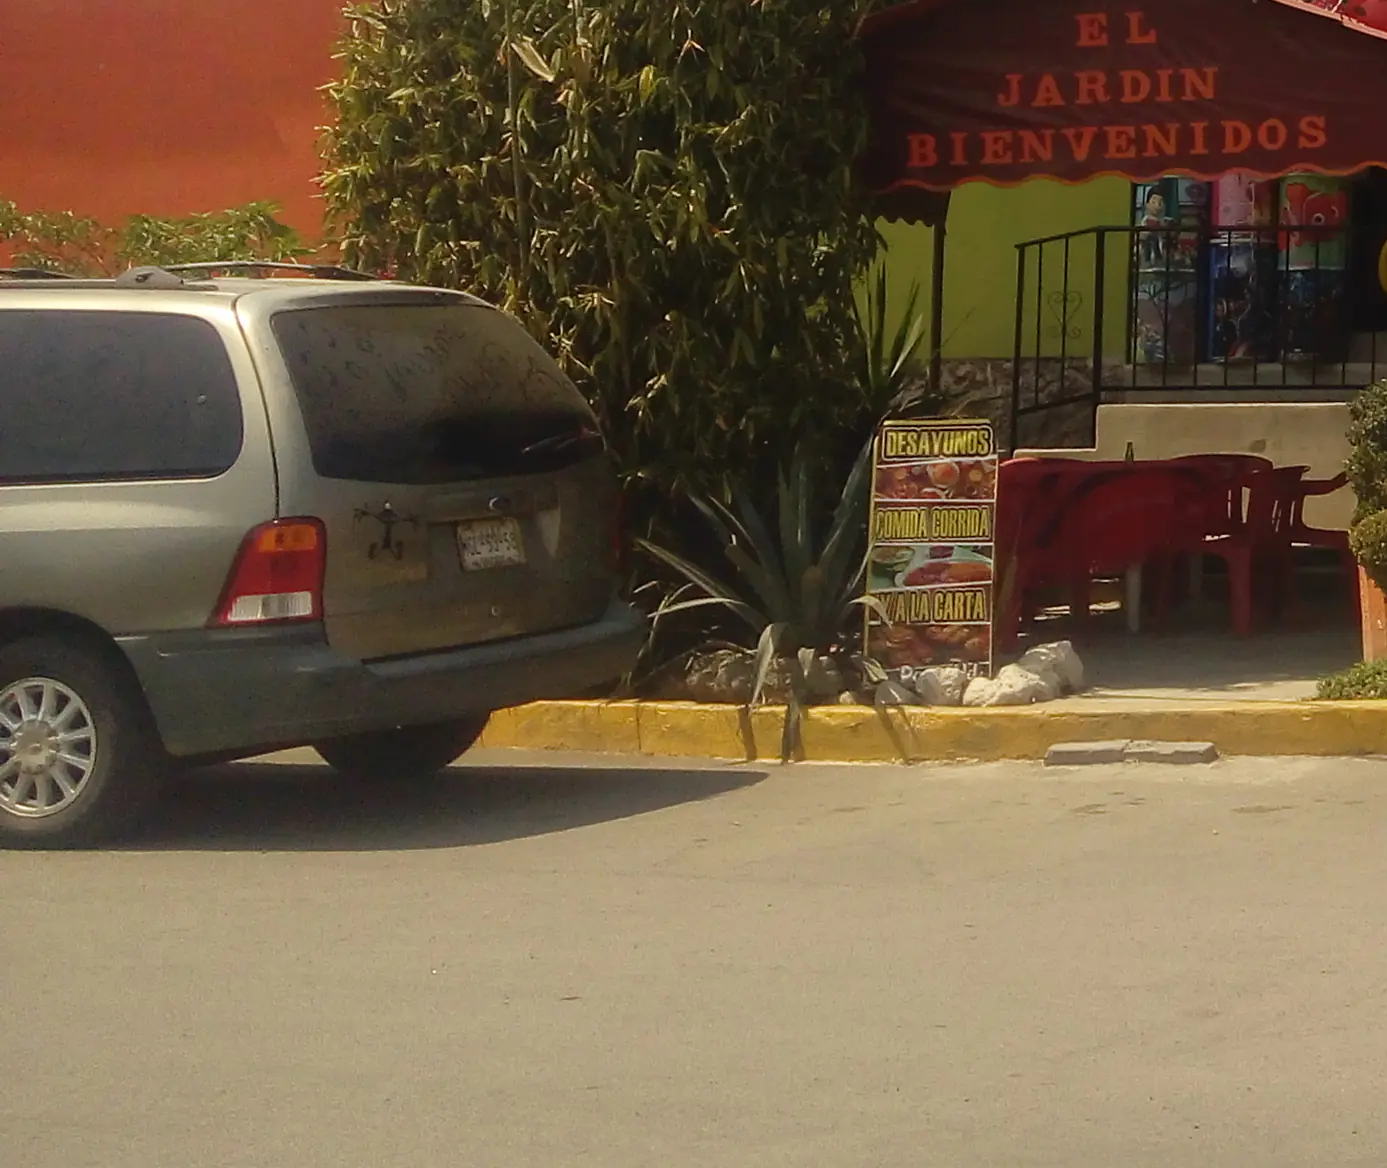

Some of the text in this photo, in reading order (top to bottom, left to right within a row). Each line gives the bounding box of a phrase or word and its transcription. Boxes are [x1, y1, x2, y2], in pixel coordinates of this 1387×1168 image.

[1074, 12, 1158, 48] EL
[998, 67, 1220, 108] JARDIN
[906, 114, 1329, 169] BIENVENIDOS
[886, 430, 991, 459] DESAYUNOS
[876, 507, 990, 540] COMIDA CORRIDA
[909, 591, 930, 620] LA
[933, 590, 985, 620] CARTA
